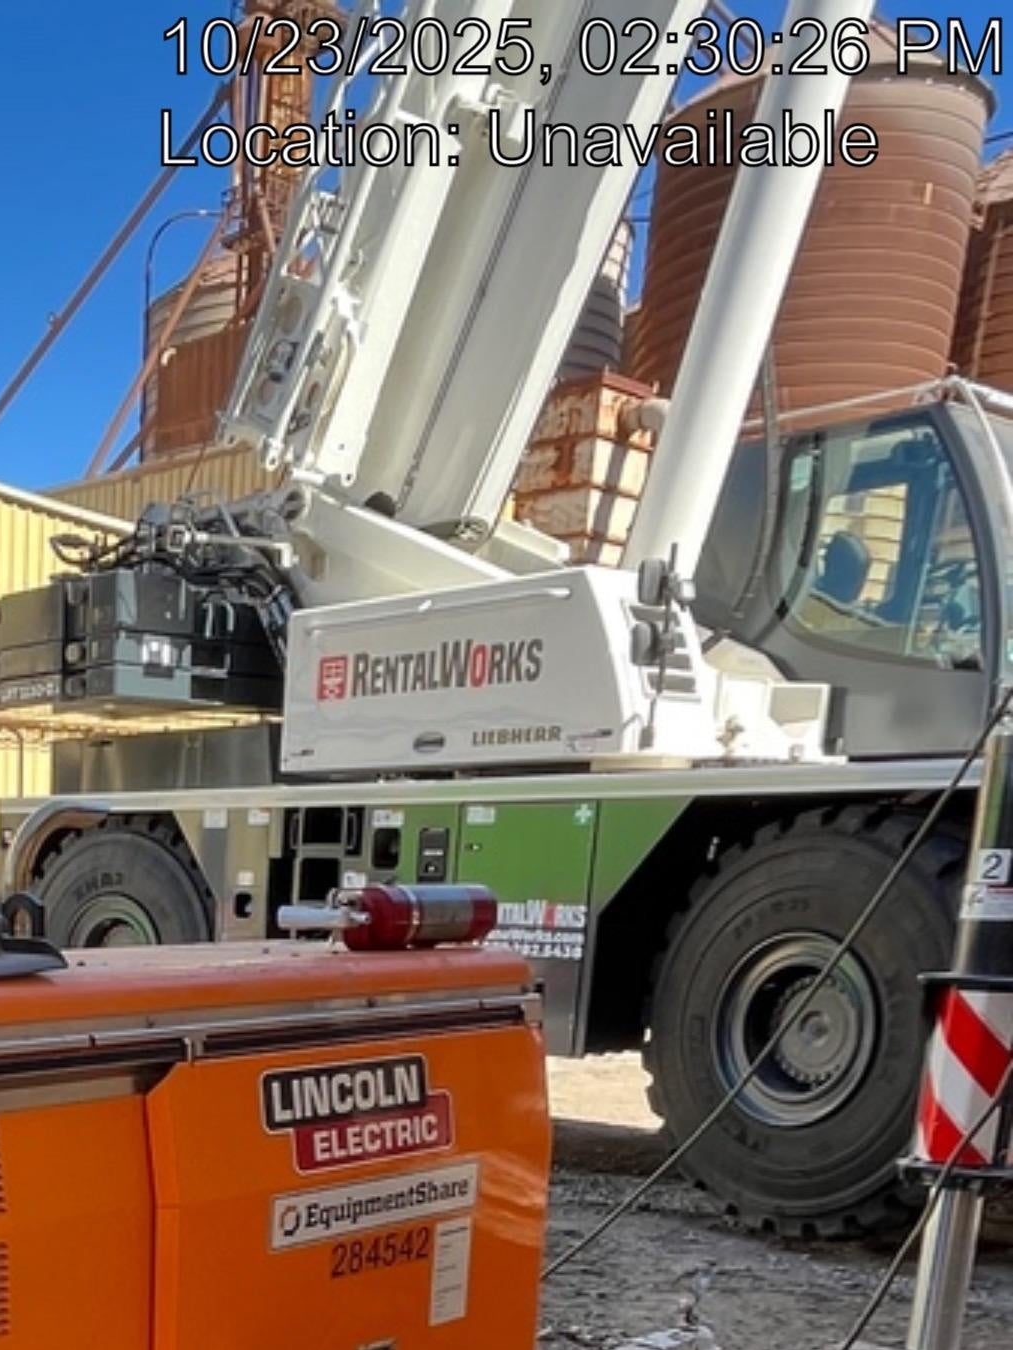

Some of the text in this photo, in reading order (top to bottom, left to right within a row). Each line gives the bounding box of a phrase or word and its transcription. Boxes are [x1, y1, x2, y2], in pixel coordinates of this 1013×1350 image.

[472, 726, 563, 747] LIEBHERR
[981, 852, 1003, 879] 2
[271, 1064, 421, 1123] LINCOLN
[313, 1114, 438, 1162] ELECTRIC
[305, 1178, 469, 1230] EquipmentShare
[331, 1226, 429, 1278] 284542
